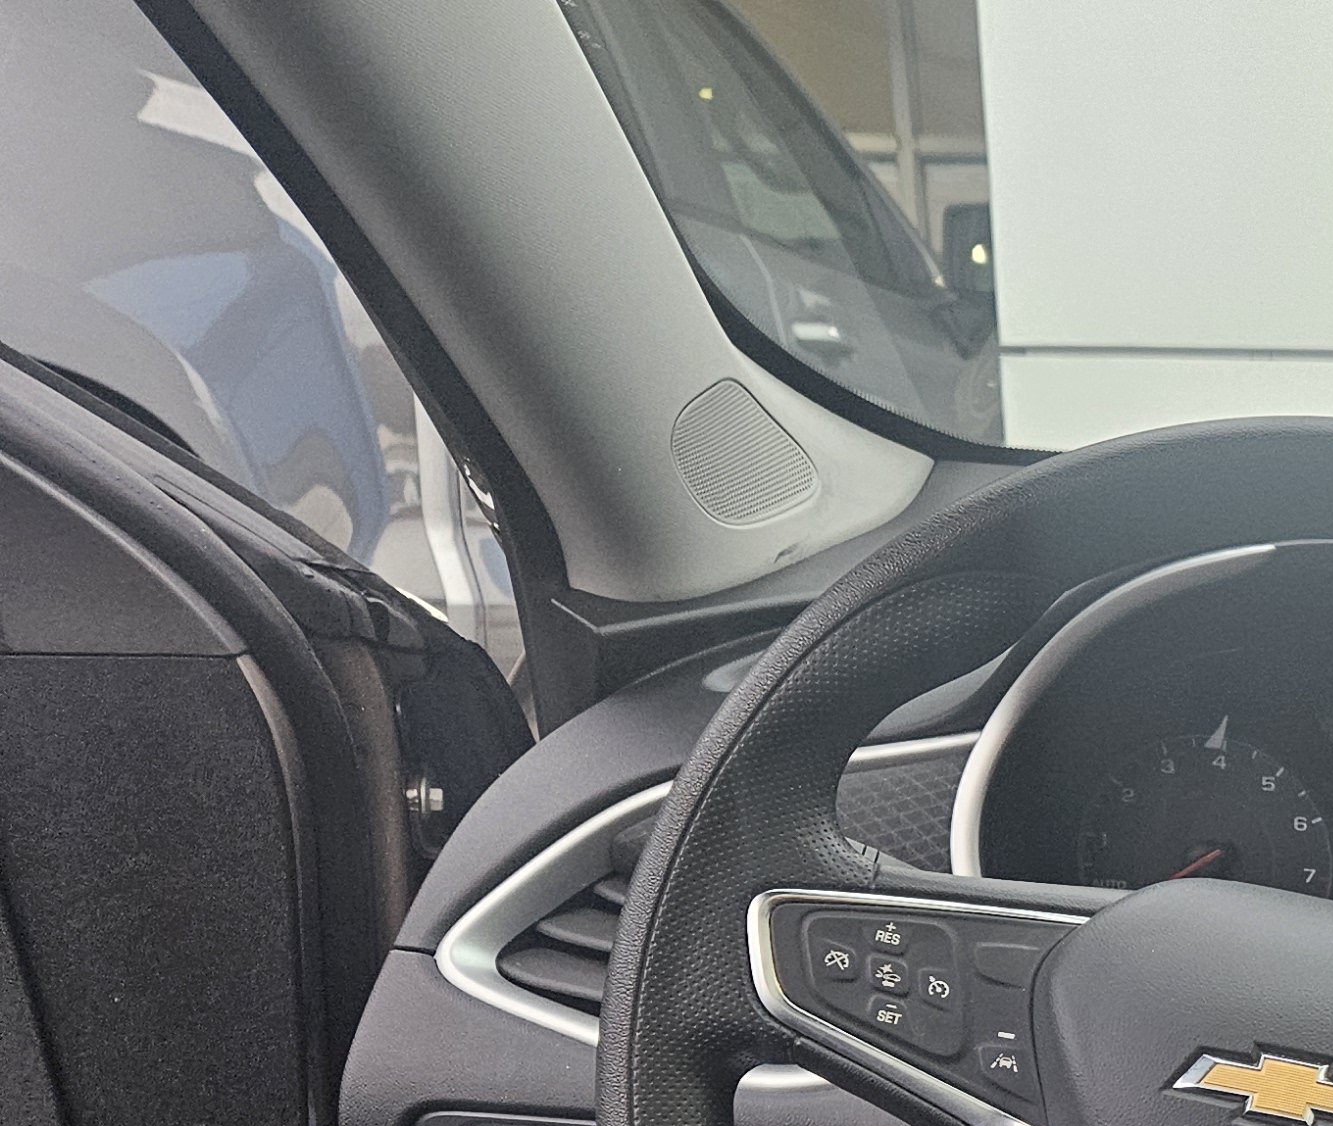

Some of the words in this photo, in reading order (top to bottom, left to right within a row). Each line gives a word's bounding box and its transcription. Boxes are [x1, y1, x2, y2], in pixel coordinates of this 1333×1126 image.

[1160, 758, 1175, 774] 3
[1211, 755, 1227, 770] 4
[1261, 776, 1276, 792] 5
[1121, 787, 1135, 802] 2
[1293, 816, 1308, 831] 6
[1303, 868, 1316, 883] 7
[875, 930, 901, 945] RES
[876, 1011, 902, 1025] SET
